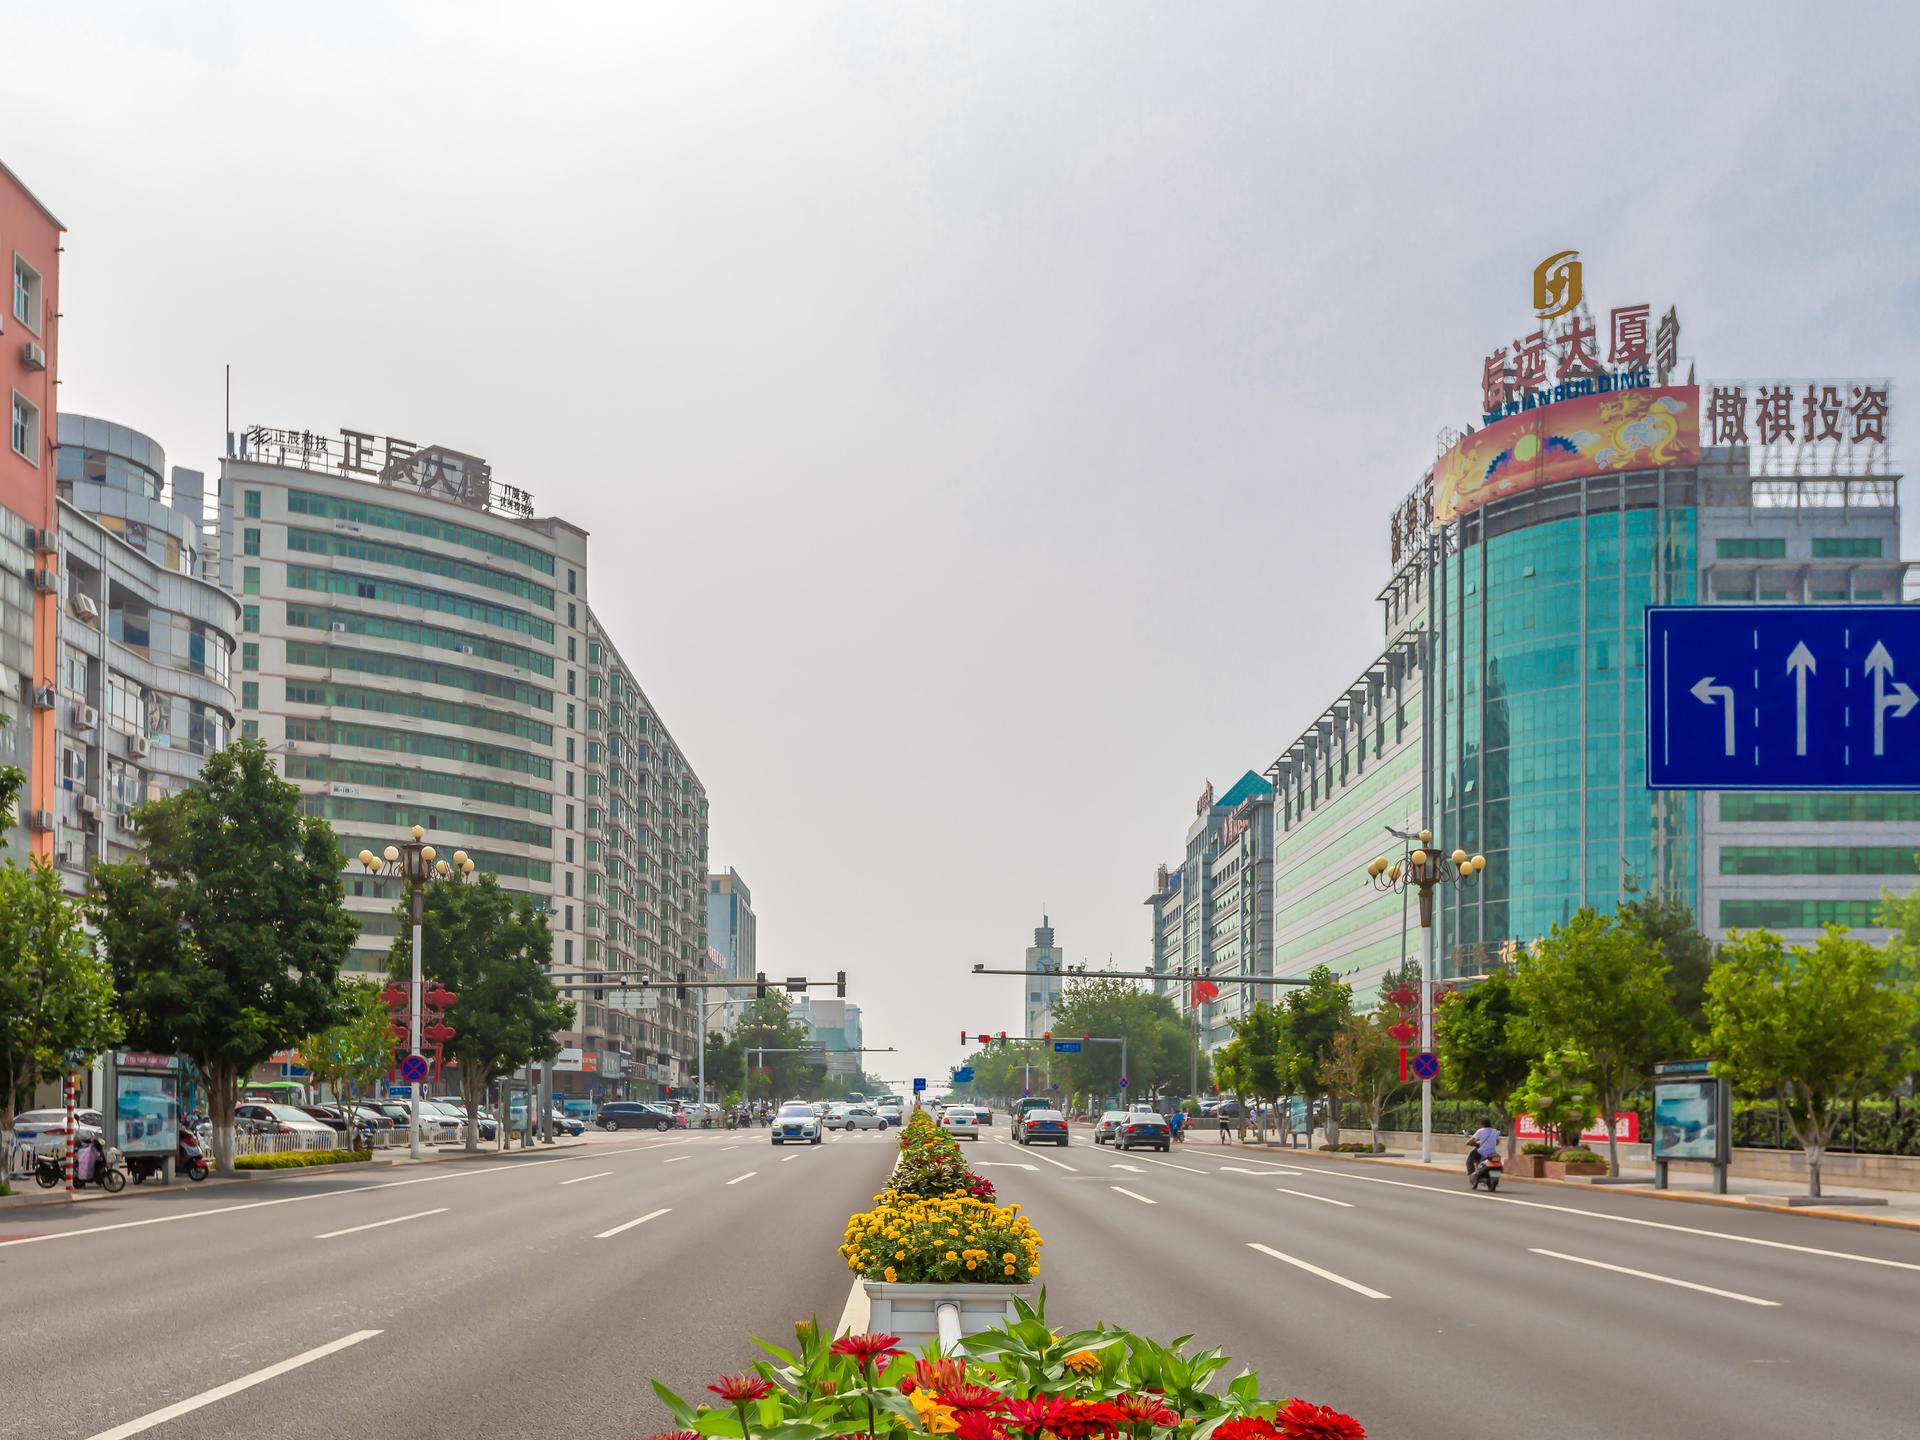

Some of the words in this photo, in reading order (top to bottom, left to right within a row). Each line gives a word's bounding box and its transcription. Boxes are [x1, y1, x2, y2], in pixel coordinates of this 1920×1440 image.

[1481, 304, 1652, 413] 信远大厦
[1707, 384, 1889, 445] 傲祺投资
[337, 428, 491, 512] 正辰大
